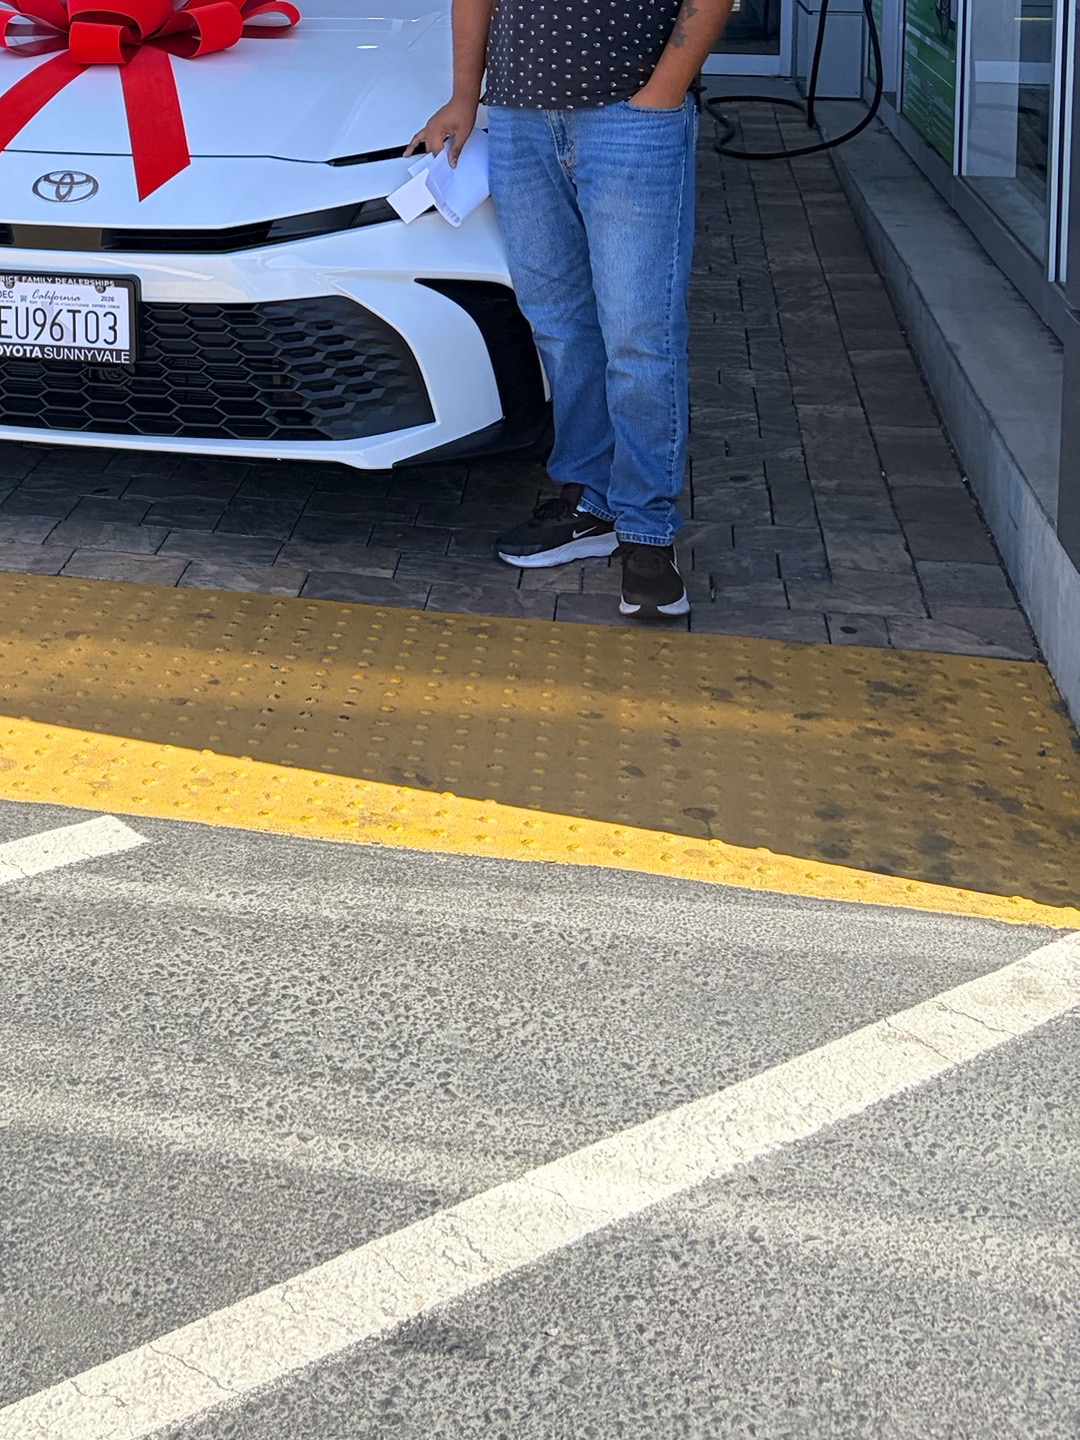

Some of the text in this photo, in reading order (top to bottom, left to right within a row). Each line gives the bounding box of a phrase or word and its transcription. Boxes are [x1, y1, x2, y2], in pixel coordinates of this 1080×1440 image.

[22, 276, 53, 284] FAMILY
[55, 278, 115, 287] DEALERSHIPS
[32, 289, 81, 305] California
[100, 295, 115, 303] 2026
[44, 347, 130, 363] SUNNYVALE
